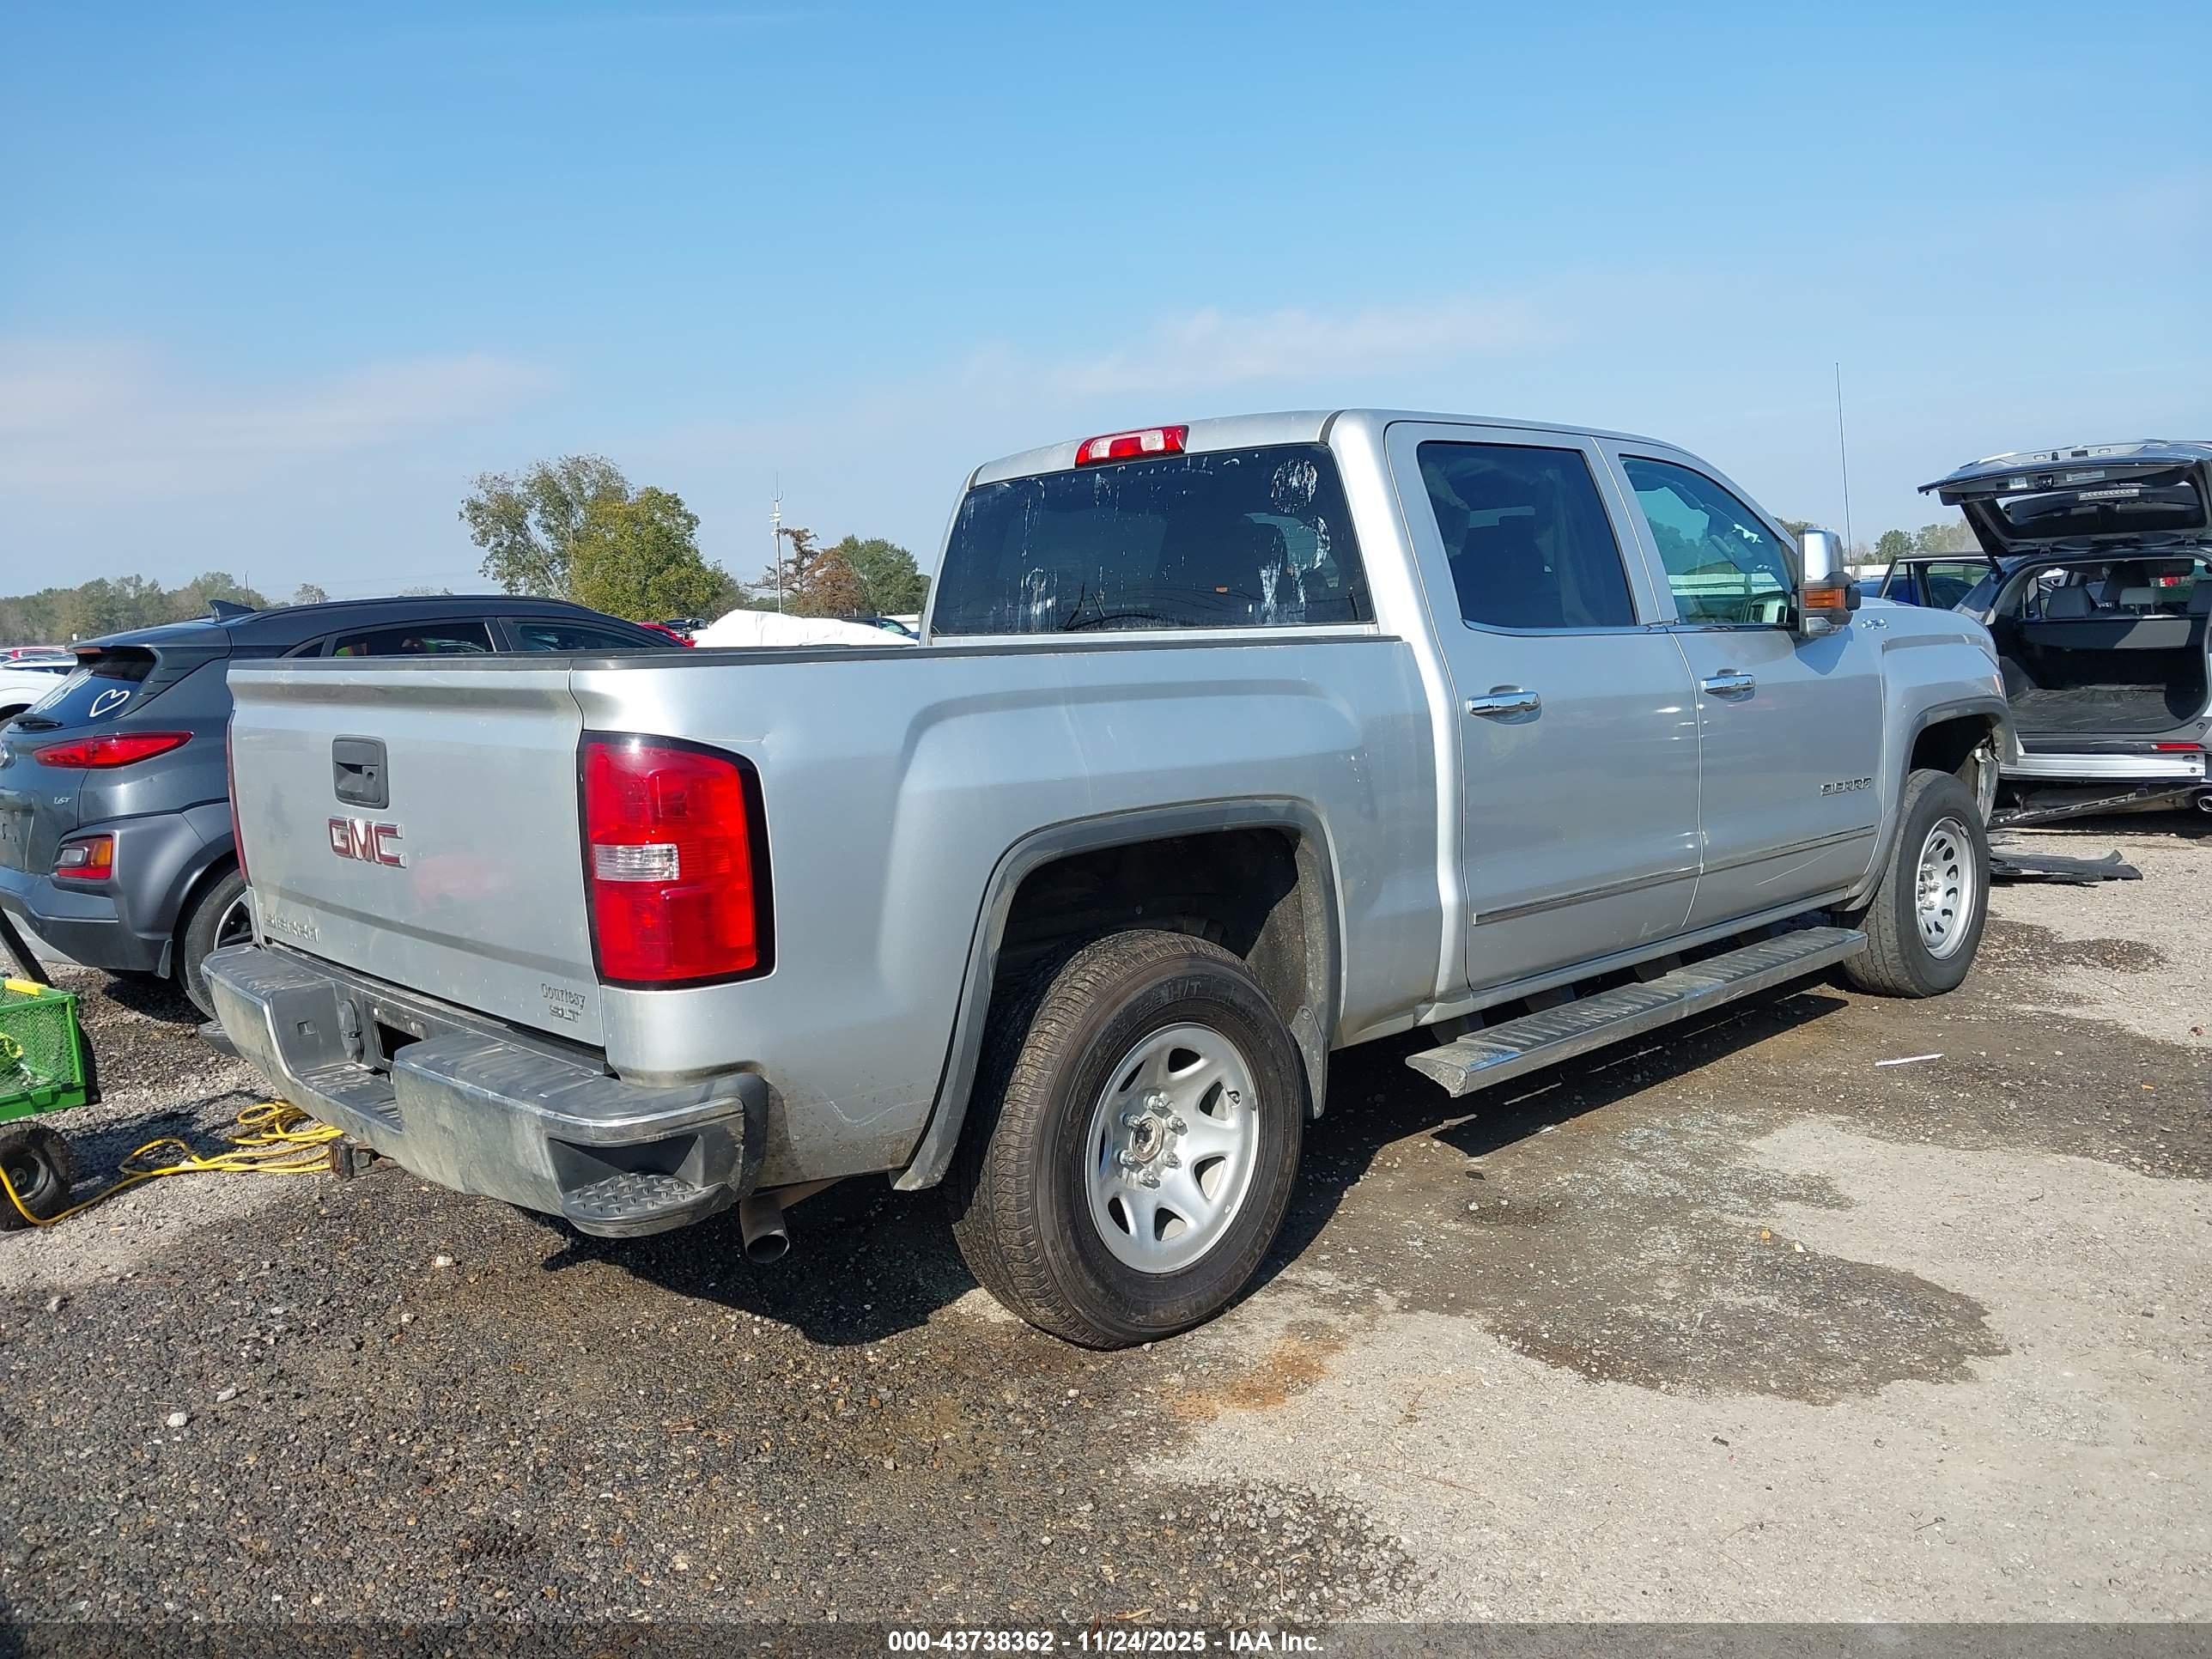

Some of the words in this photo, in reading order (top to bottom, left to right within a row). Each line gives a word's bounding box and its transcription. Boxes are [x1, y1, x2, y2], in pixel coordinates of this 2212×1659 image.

[328, 817, 407, 869] GMC
[541, 982, 586, 1010] Courtesy
[550, 1006, 581, 1023] SLT
